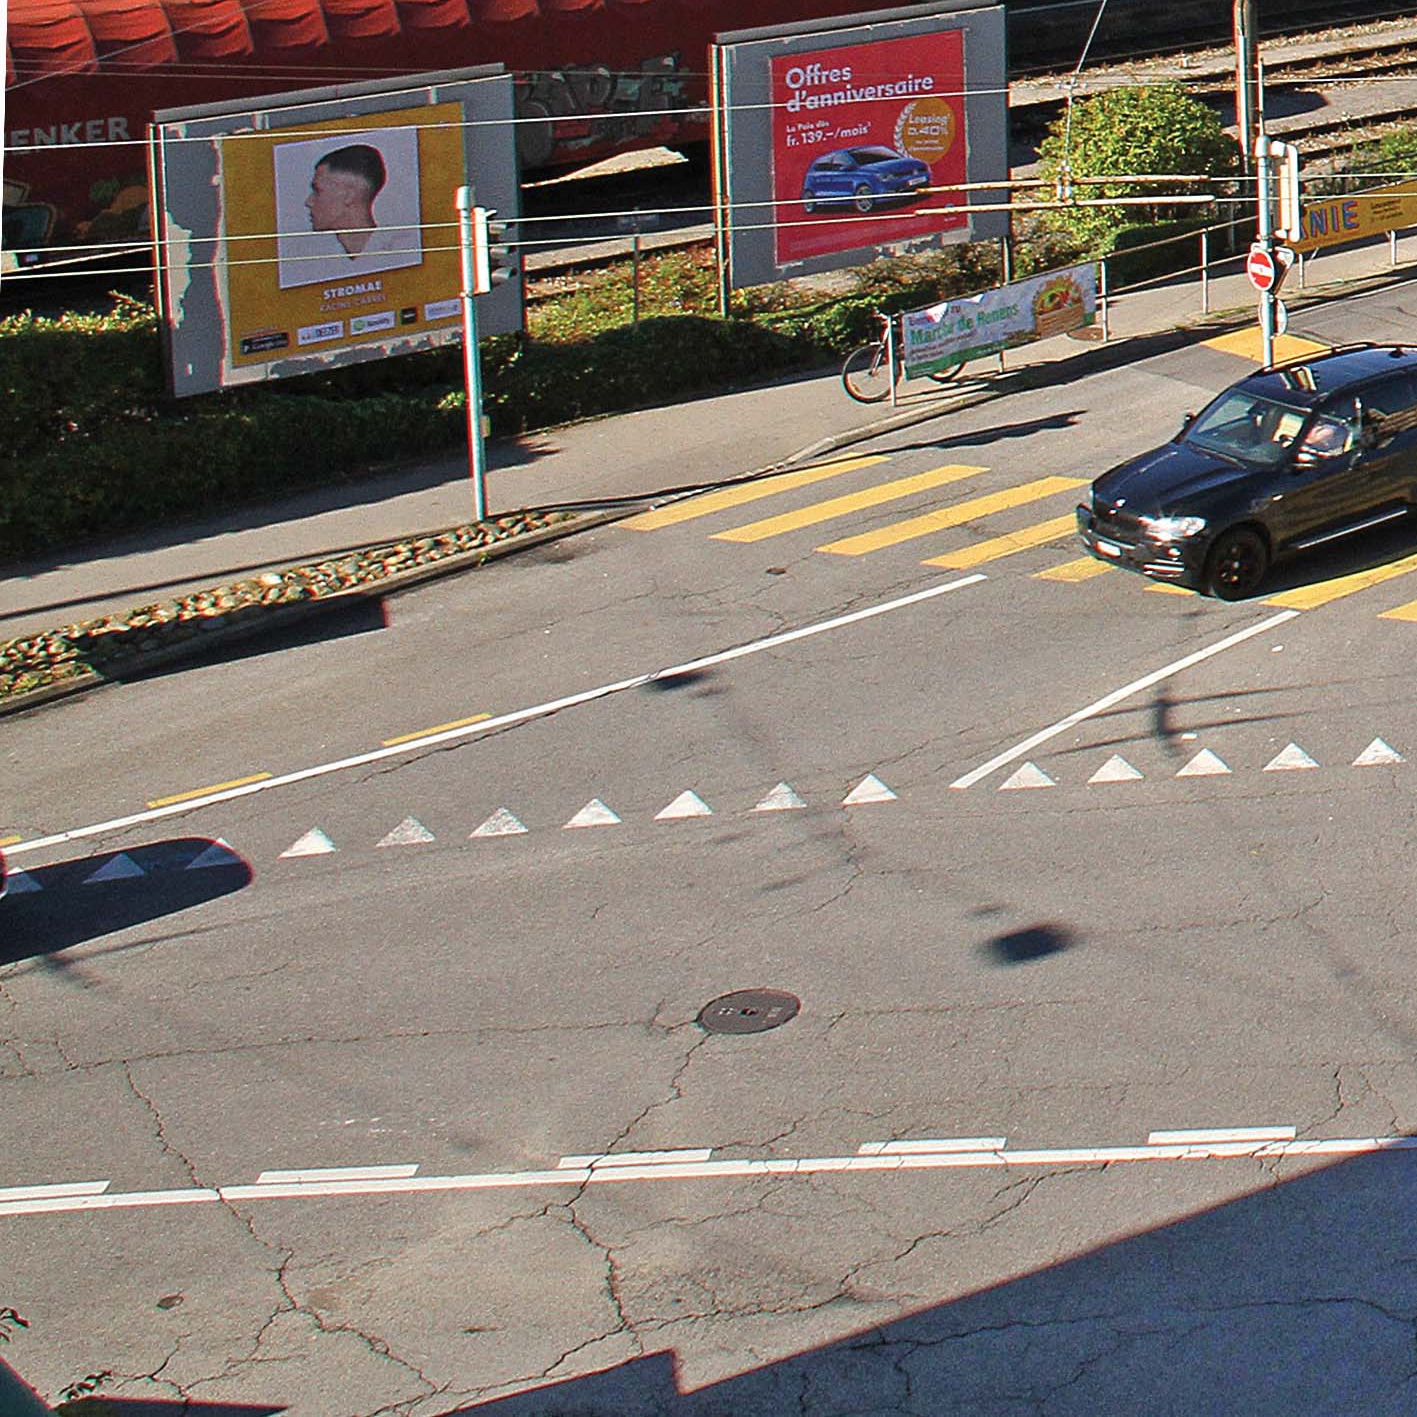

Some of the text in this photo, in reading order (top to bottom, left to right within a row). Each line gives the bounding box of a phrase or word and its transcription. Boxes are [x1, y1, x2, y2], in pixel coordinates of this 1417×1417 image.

[785, 63, 852, 89] Offres
[786, 74, 934, 112] d'anniversaire
[786, 136, 800, 148] fr.
[323, 281, 382, 300] STROMAE
[958, 315, 974, 331] de
